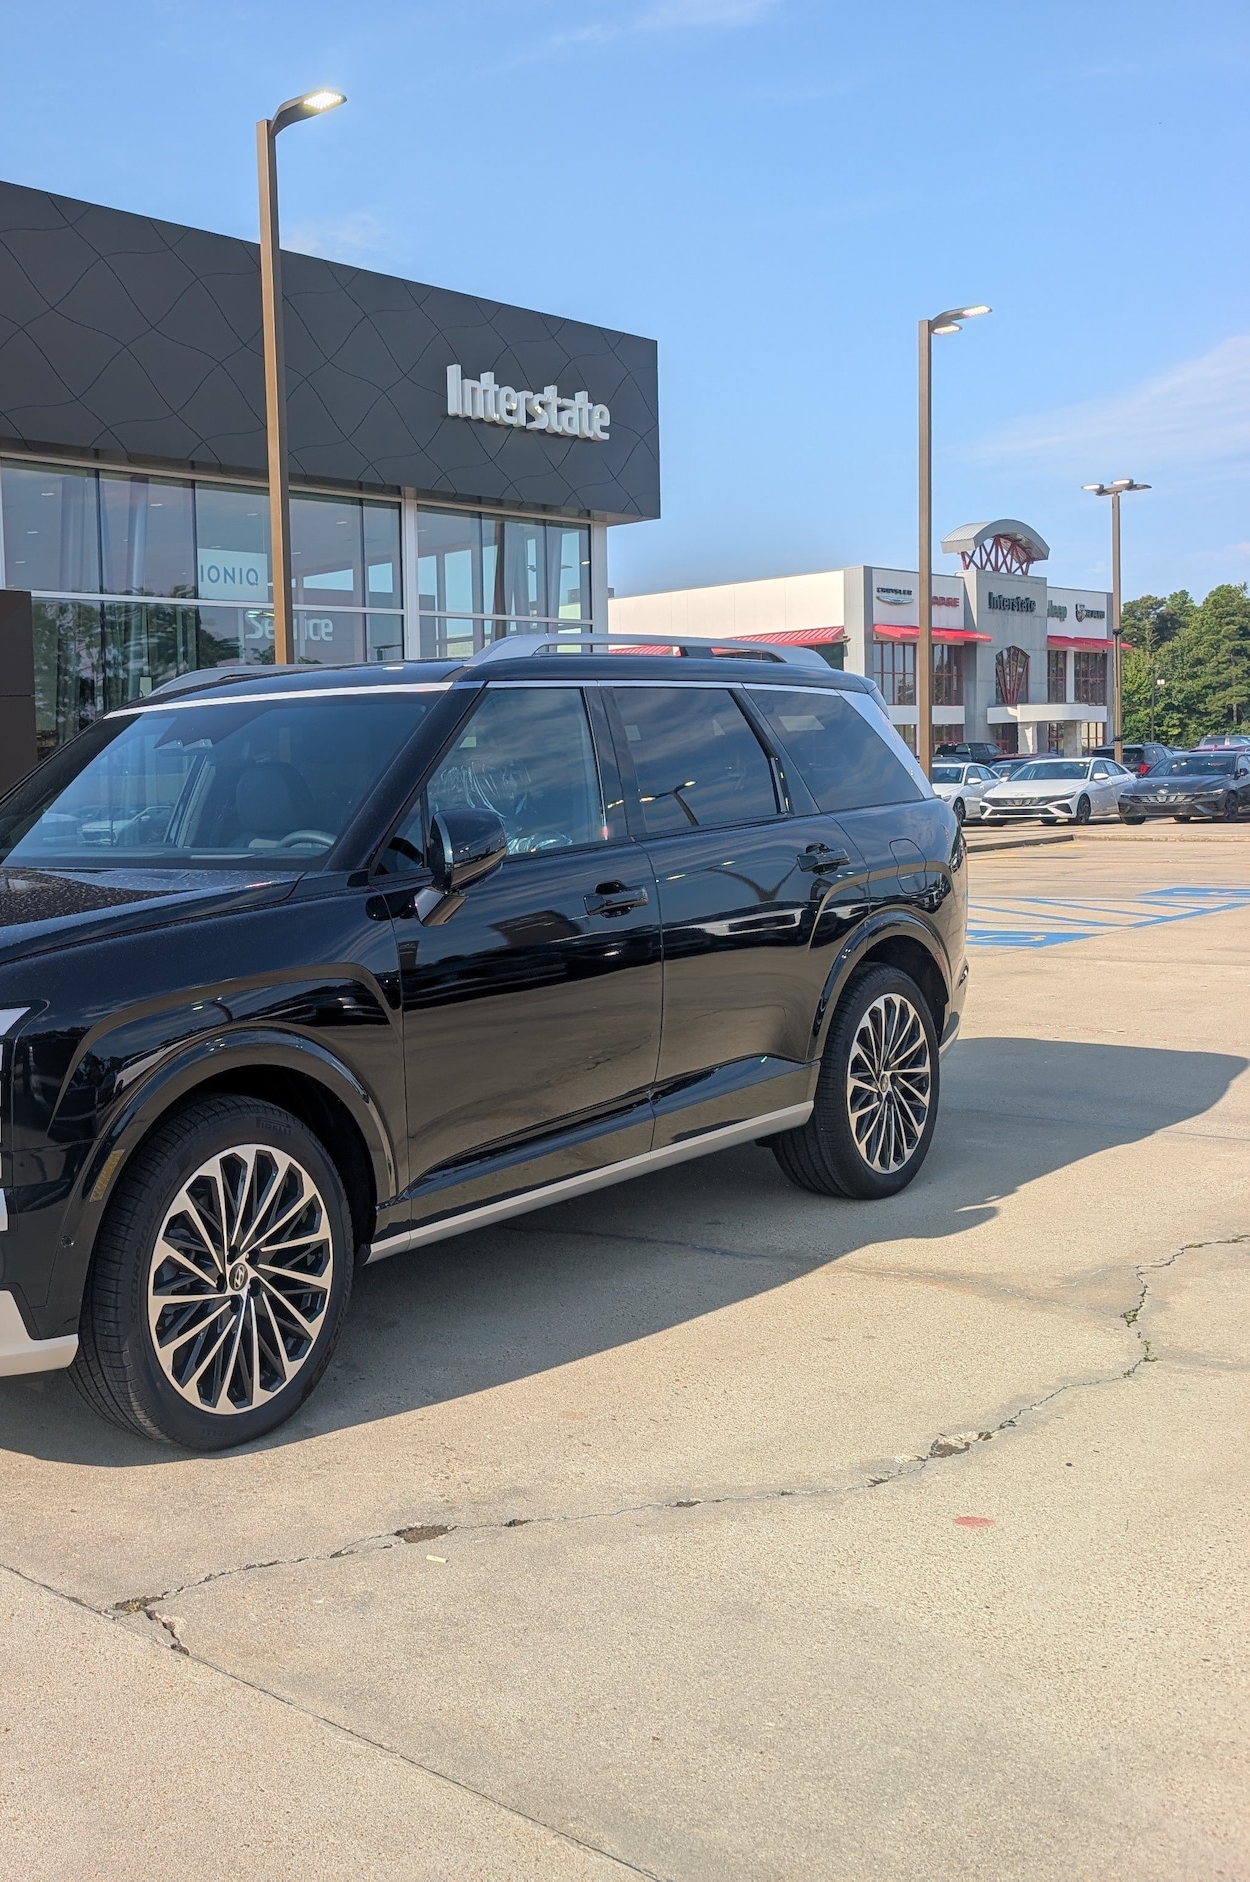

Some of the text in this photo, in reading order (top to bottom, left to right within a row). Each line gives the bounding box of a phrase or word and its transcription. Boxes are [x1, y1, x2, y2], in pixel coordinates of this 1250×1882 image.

[447, 364, 611, 441] Interstate
[200, 564, 259, 586] IONIQ
[932, 595, 960, 607] ODGE
[988, 591, 1036, 613] Interstate
[244, 611, 334, 641] Seice
